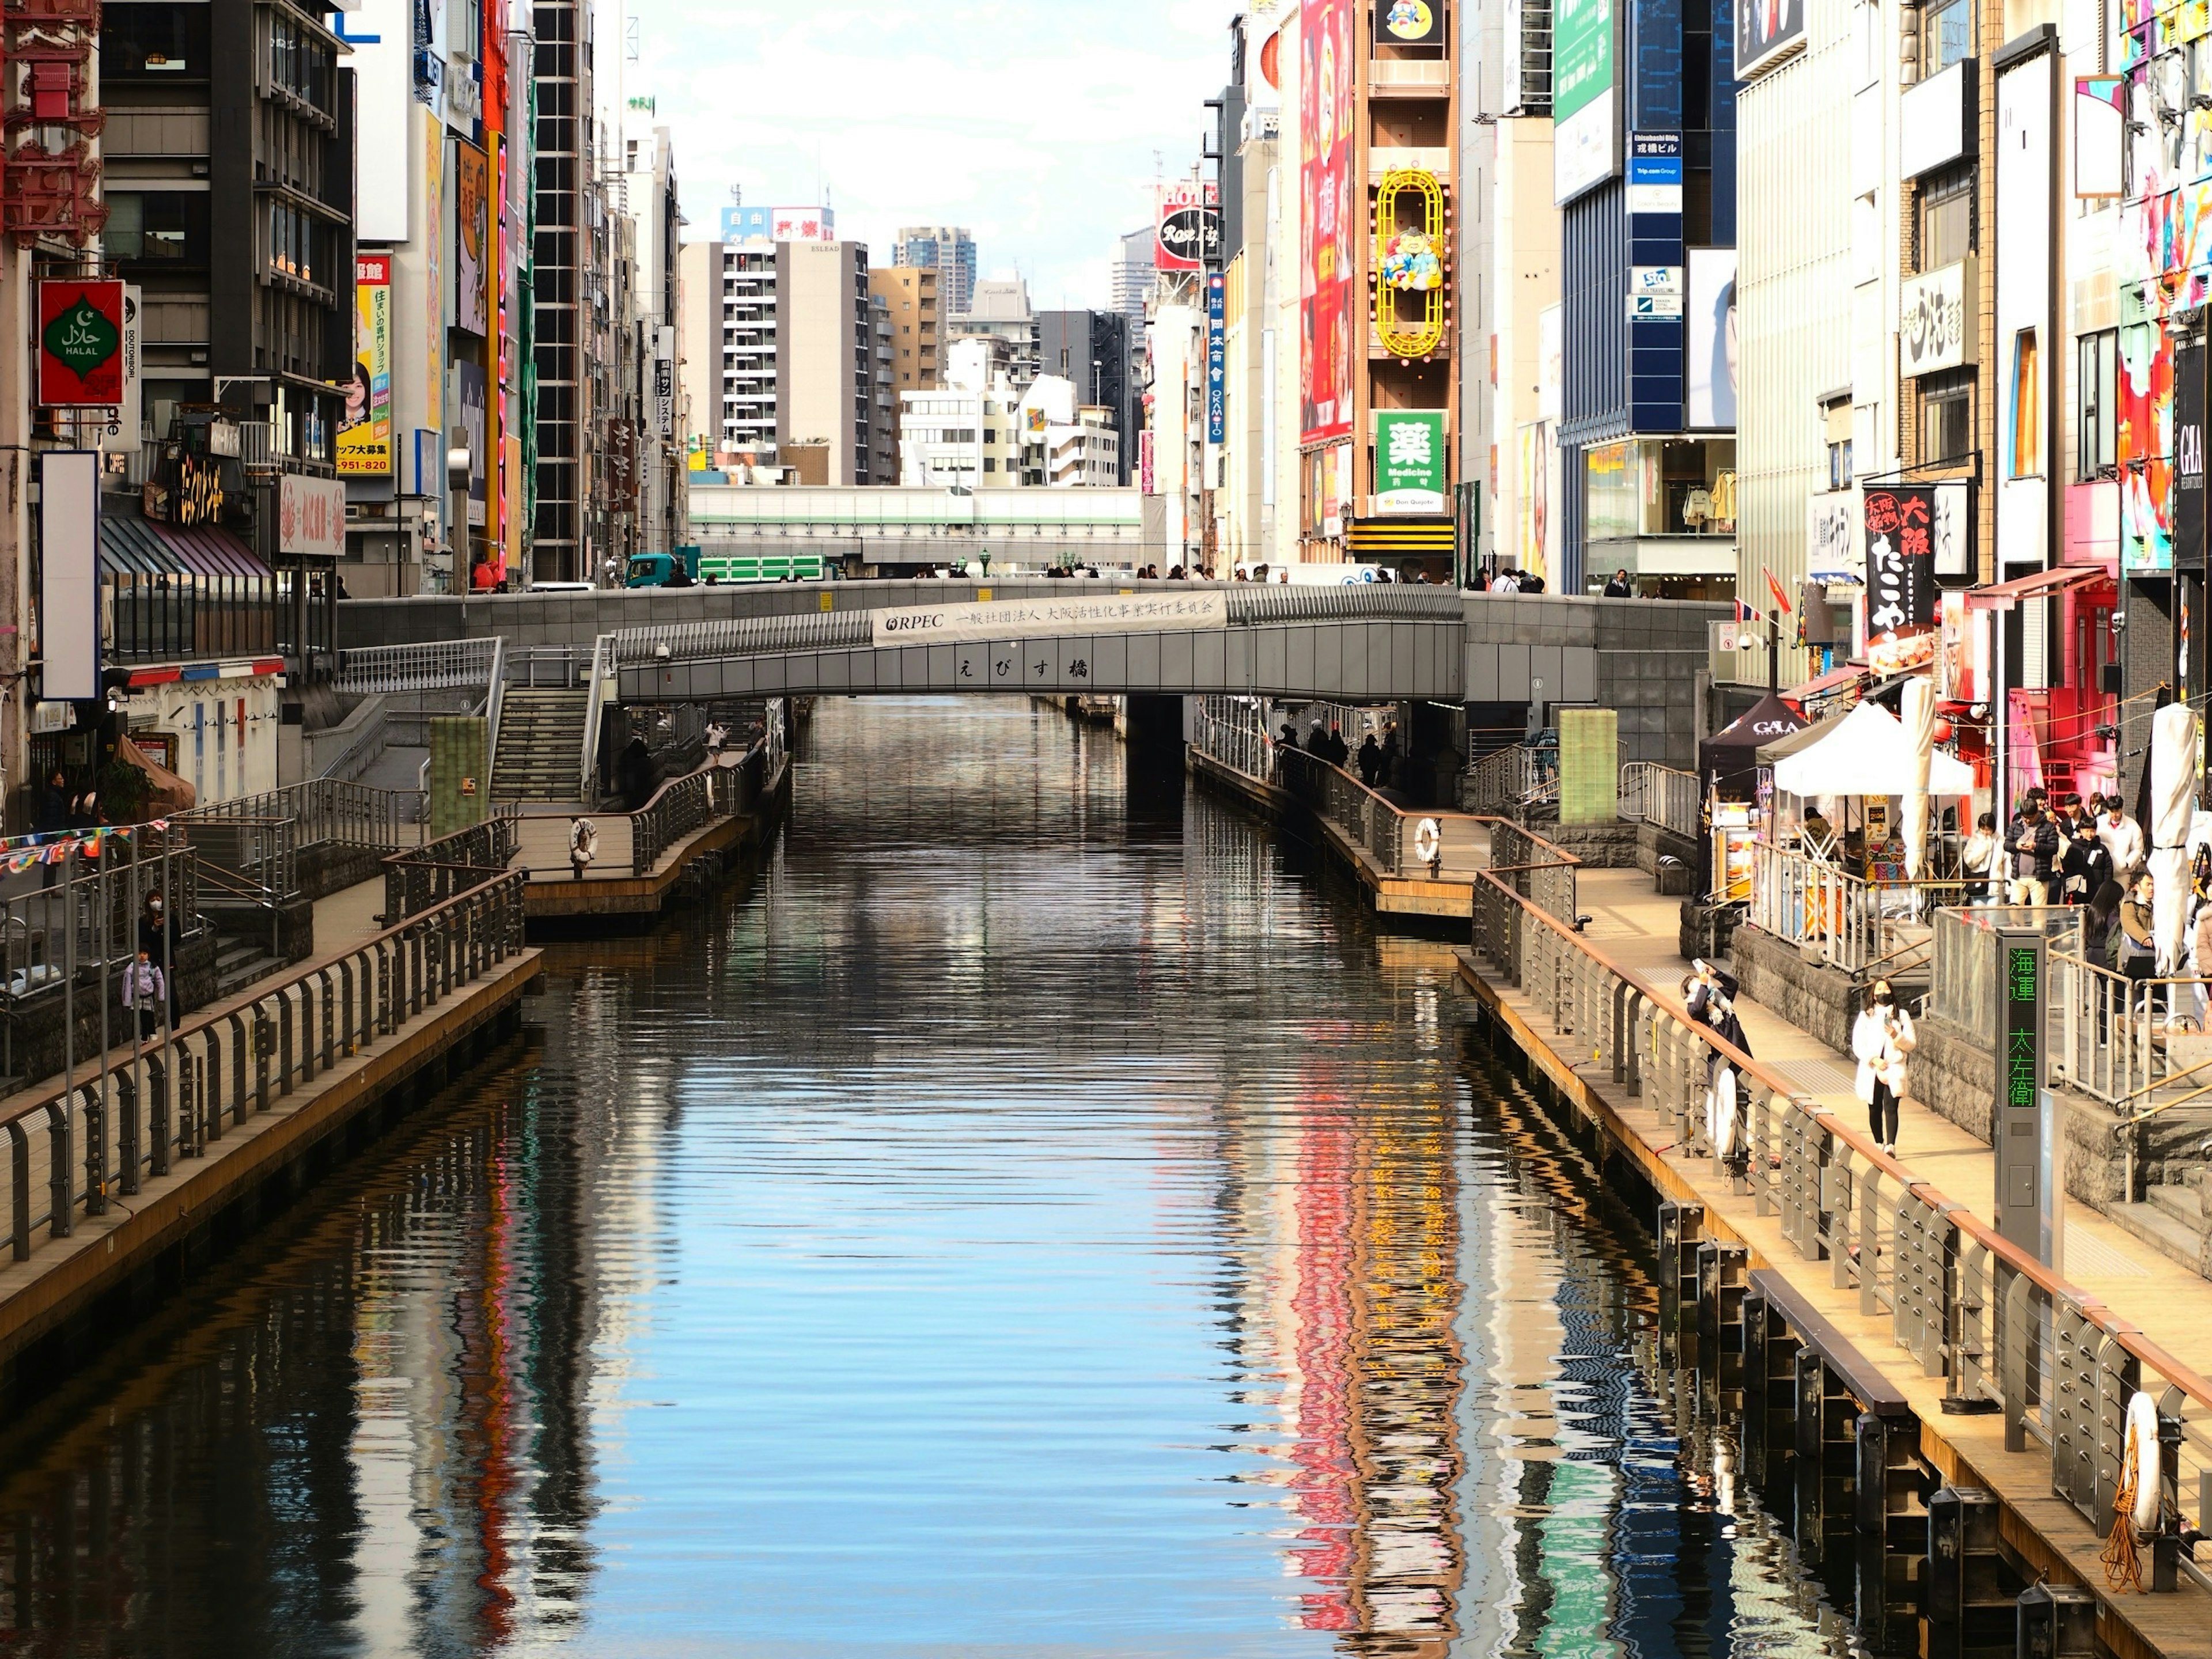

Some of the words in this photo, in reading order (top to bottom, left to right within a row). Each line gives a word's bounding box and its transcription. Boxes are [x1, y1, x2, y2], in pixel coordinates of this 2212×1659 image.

[1637, 143, 1677, 153] 戎橋ビル
[1163, 190, 1219, 205] HOTE
[62, 324, 100, 346] حلال
[375, 290, 385, 373] 住まいの専門ショップ
[66, 347, 97, 355] HALAL
[107, 407, 122, 436] afe
[1212, 389, 1222, 435] OKAMOTO
[1389, 422, 1431, 465] 薬
[337, 461, 387, 469] -951-820
[1388, 468, 1432, 476] Medicine
[1393, 478, 1401, 486] 药
[1419, 478, 1428, 487] 약
[1866, 498, 1894, 514] 大阪
[1901, 495, 1930, 556] 大阪
[885, 614, 944, 631] ORPEC
[956, 609, 1040, 624] 一般社団法人
[1047, 600, 1213, 620] 大阪活性化事業実行委員会
[960, 659, 1088, 678] えびす橋
[2009, 949, 2035, 1001] 海運
